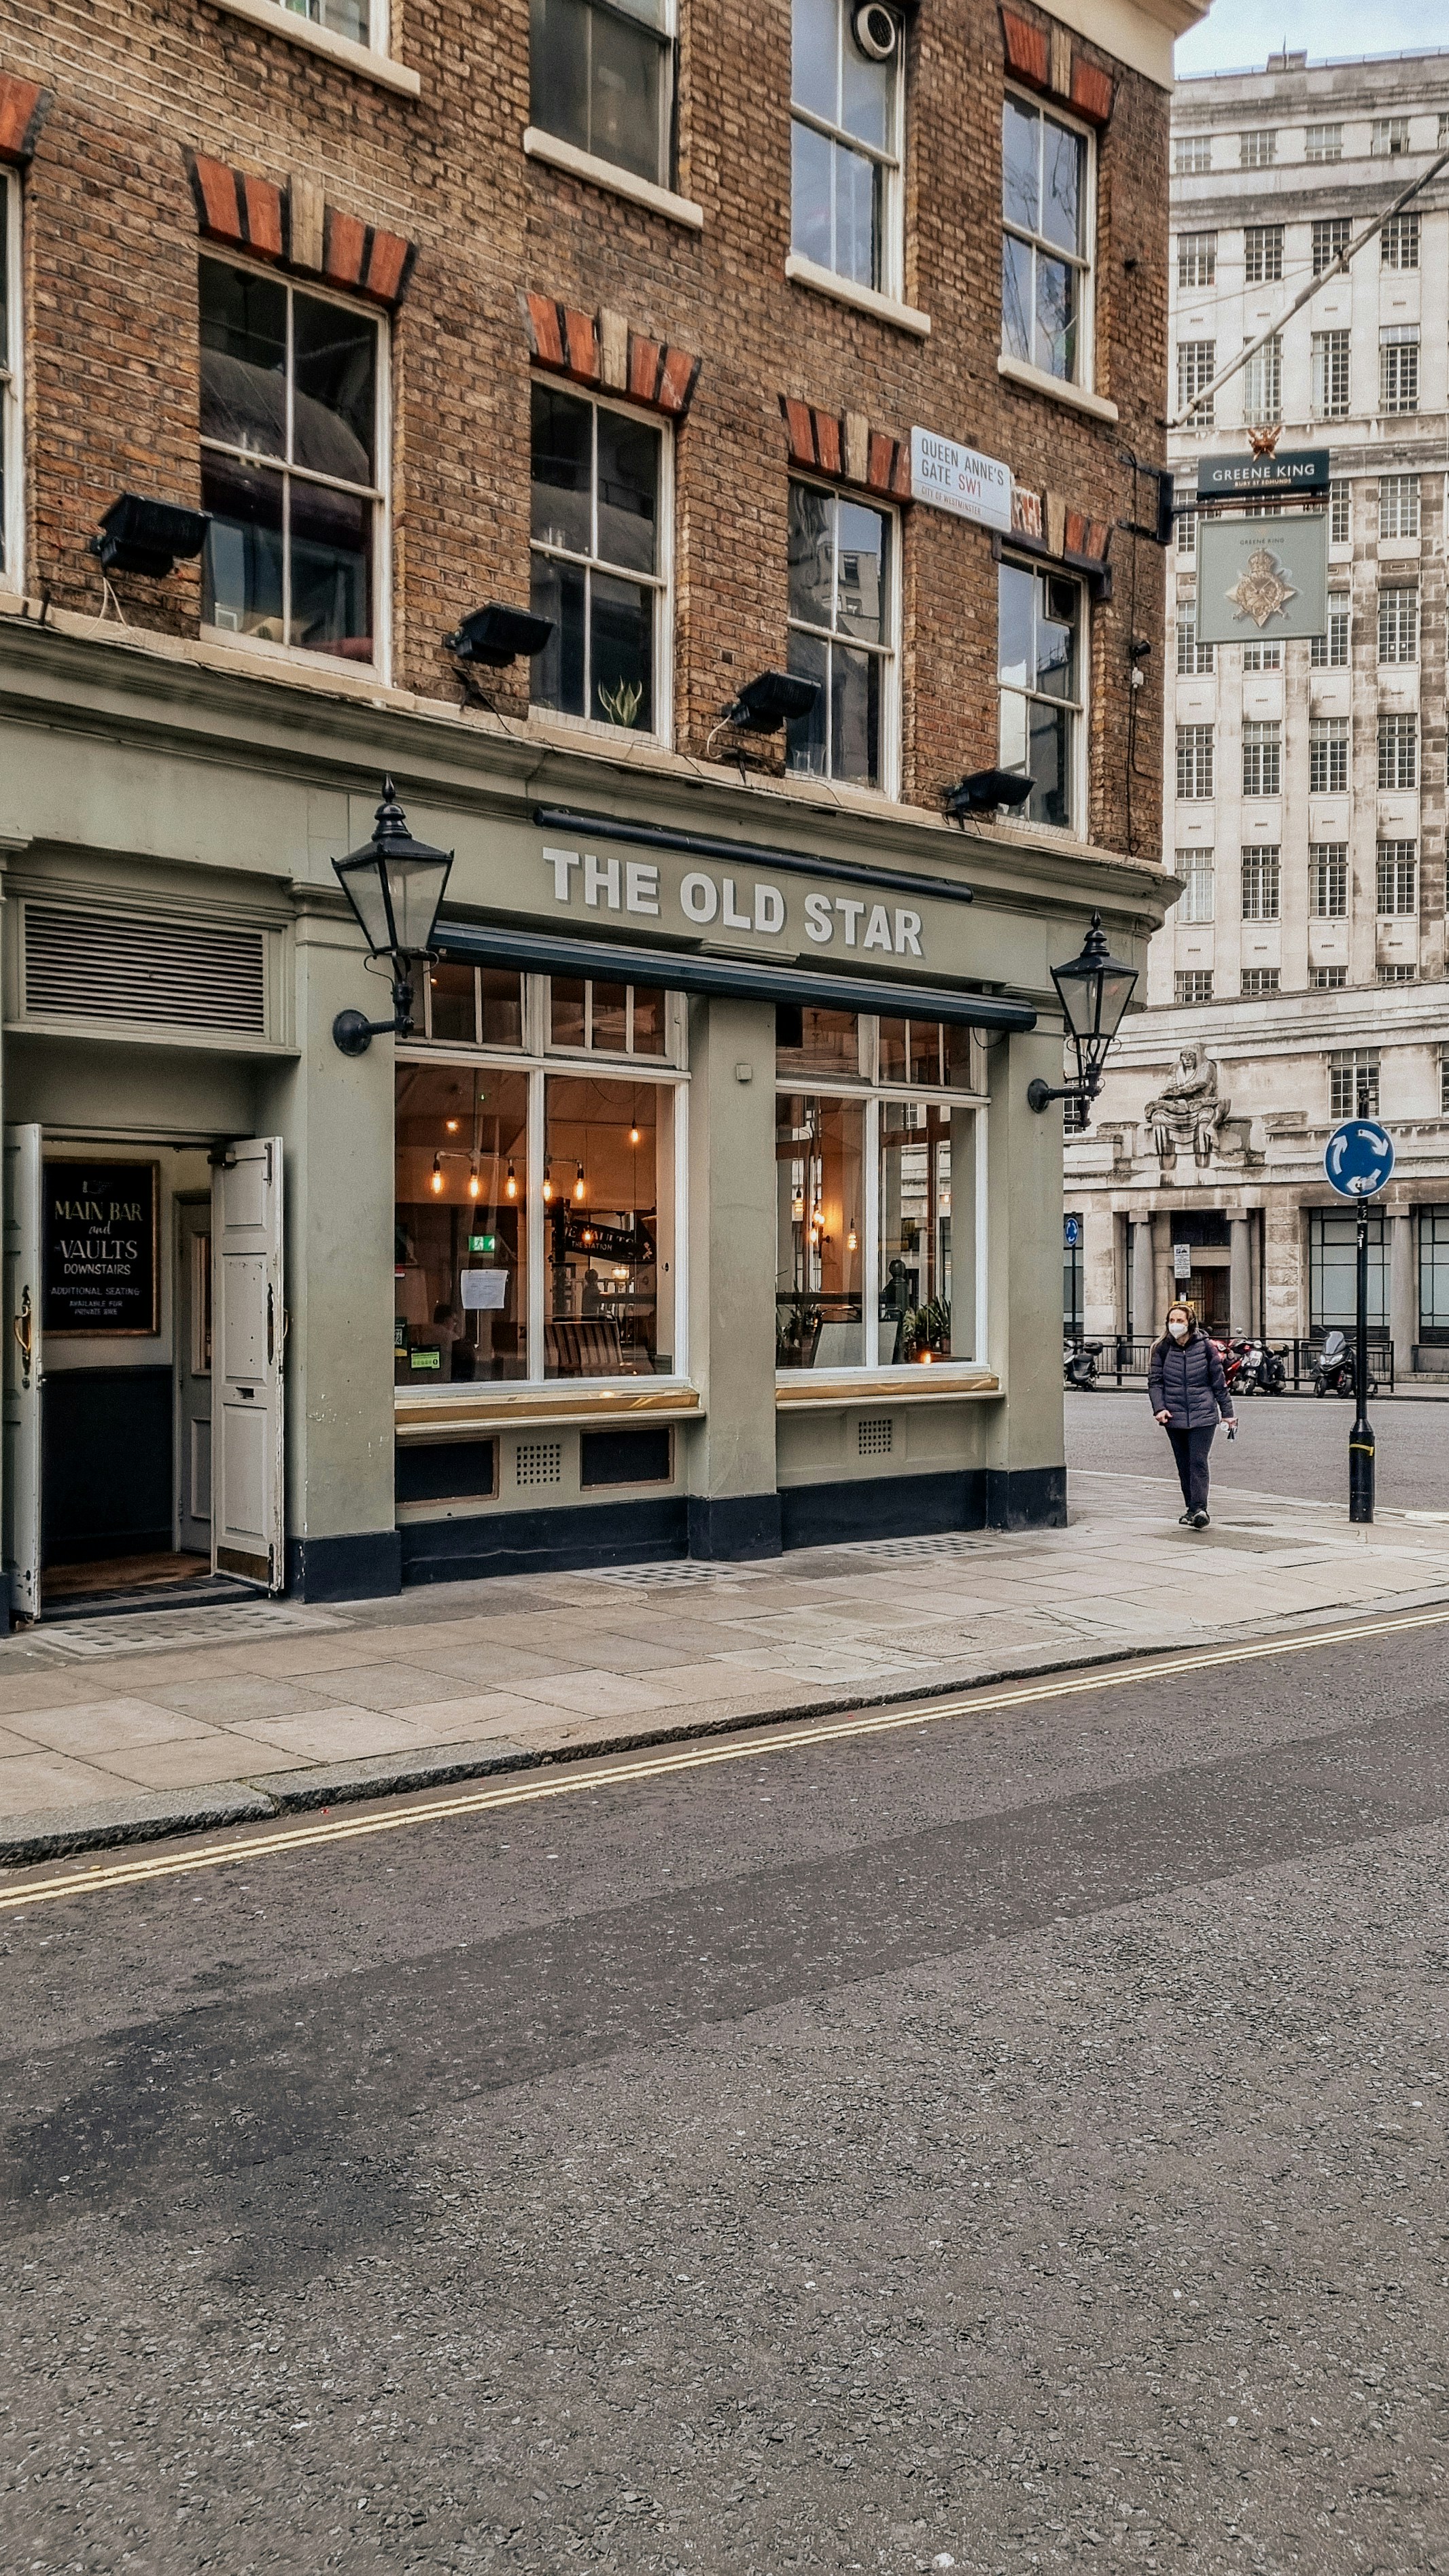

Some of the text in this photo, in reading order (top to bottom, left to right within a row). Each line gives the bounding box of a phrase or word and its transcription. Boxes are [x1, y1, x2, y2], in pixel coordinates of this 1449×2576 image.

[922, 437, 1004, 486] QUEEN ANNE'S
[922, 458, 981, 498] GATE SW1
[1212, 464, 1315, 481] GREENE KING
[922, 486, 981, 515] CITY OF WESTMINSTER
[542, 847, 923, 957] THE OLD STAR
[55, 1200, 143, 1221] MAIN BAR
[88, 1221, 111, 1235] and
[60, 1240, 138, 1259] VAULTS
[584, 1242, 612, 1251] STATION
[64, 1264, 131, 1275] DOWNSTAIRS
[51, 1287, 141, 1295] ADDITIONAL SEATING
